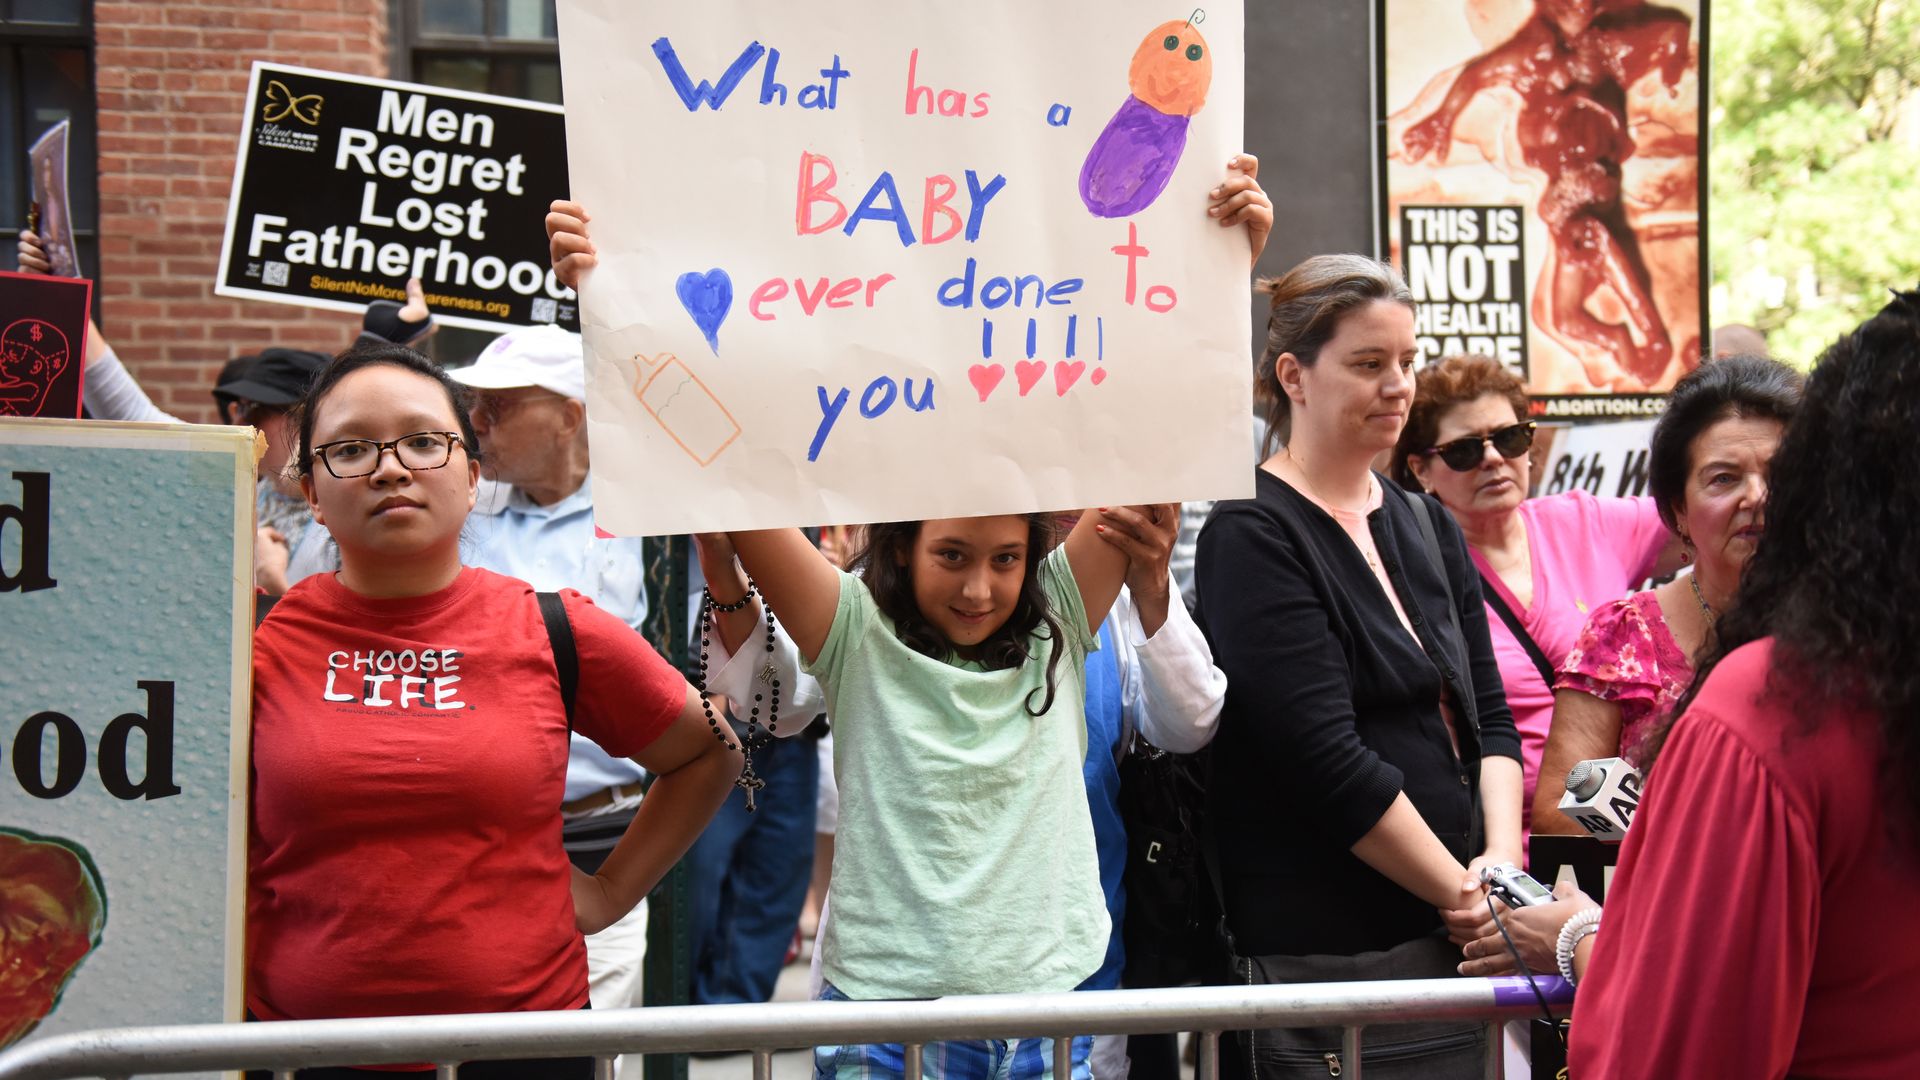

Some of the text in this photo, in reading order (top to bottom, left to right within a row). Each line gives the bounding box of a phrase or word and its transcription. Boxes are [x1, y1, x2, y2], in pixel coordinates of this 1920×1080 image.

[650, 37, 1071, 127] What has a
[376, 90, 495, 148] Men
[334, 127, 527, 196] Regret
[359, 181, 488, 241] Lost
[795, 151, 1006, 247] BABY
[1405, 208, 1519, 243] THIS IS
[310, 274, 511, 317] SilentNoMoreareness.org
[749, 221, 1178, 320] ever done to
[1407, 244, 1520, 302] NOT
[1413, 302, 1522, 336] HEALTH
[808, 376, 935, 462] you
[1529, 398, 1668, 417] NABORTION.CO
[1546, 451, 1605, 497] 8th
[327, 649, 461, 673] CHOOSE
[0, 680, 182, 801] od
[1576, 814, 1614, 833] AP
[1609, 772, 1640, 829] AP
